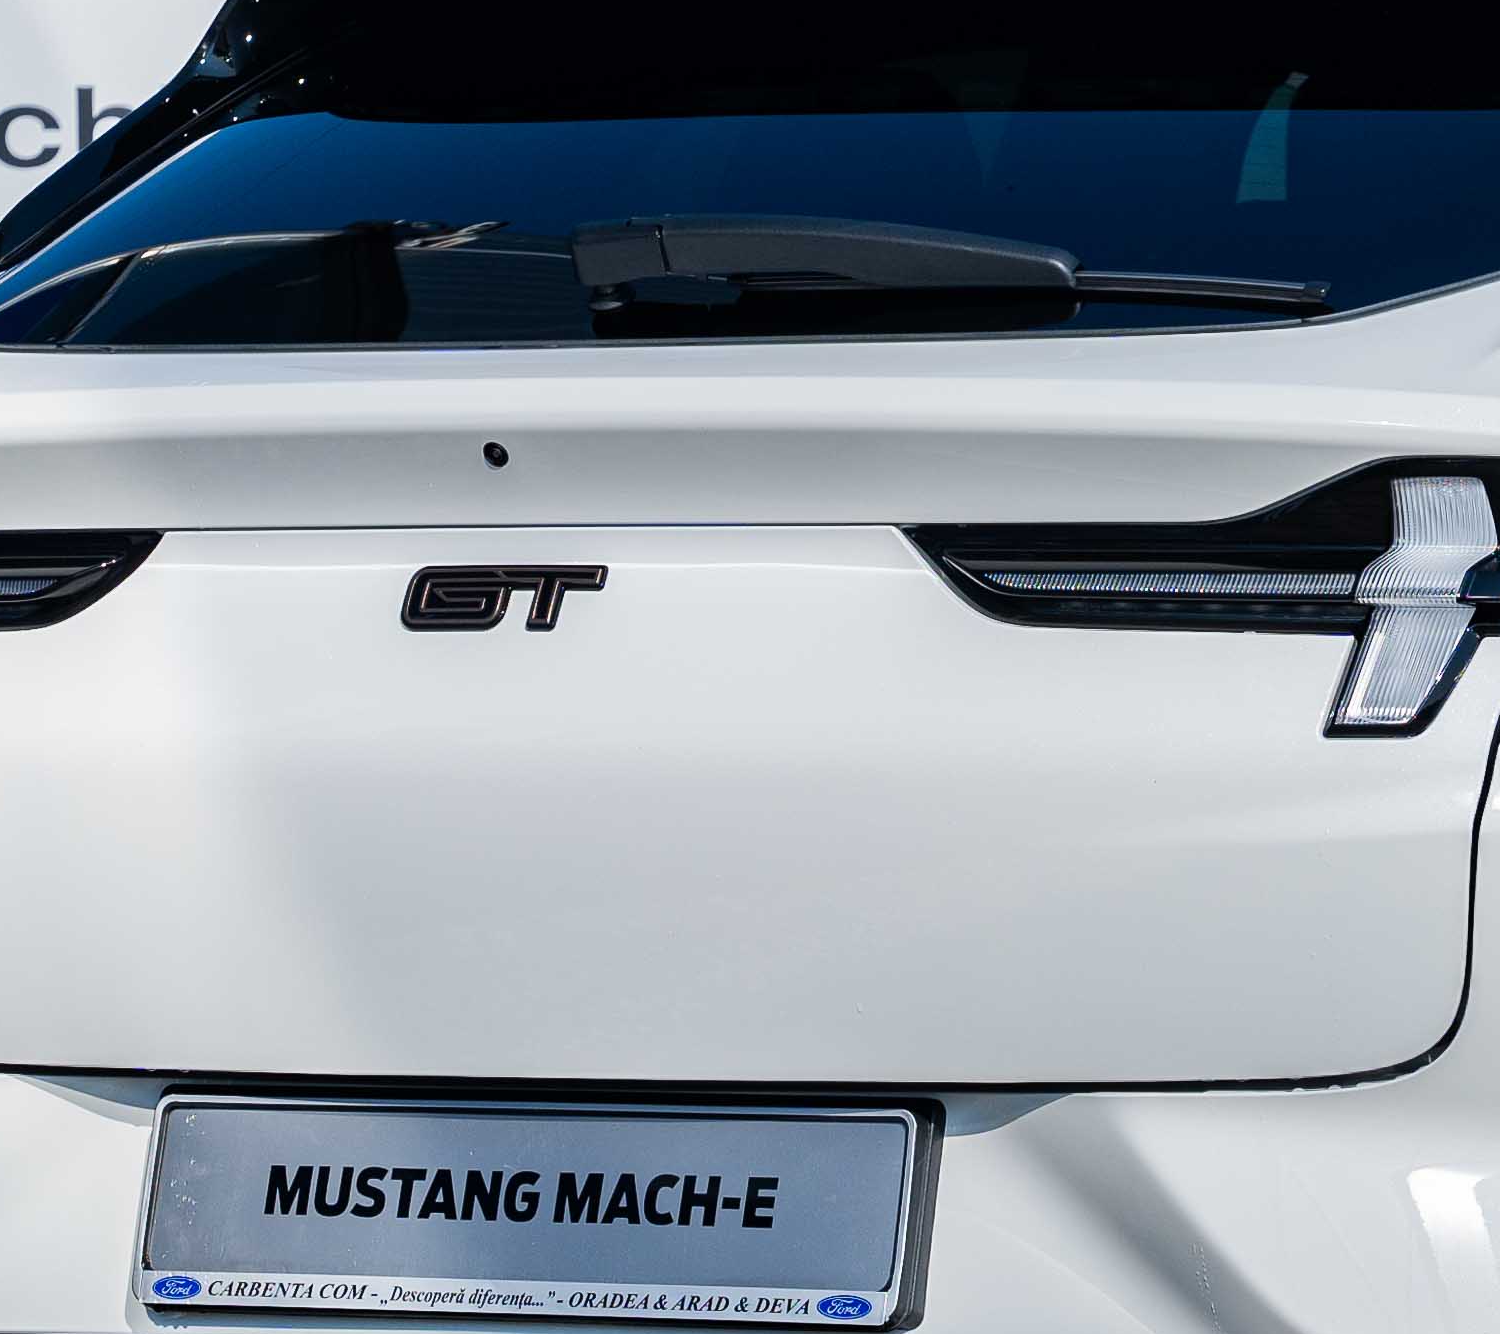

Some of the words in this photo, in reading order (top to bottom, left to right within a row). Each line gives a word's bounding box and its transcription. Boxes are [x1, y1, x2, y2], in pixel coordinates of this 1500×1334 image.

[400, 564, 609, 633] GT
[264, 1165, 541, 1223] MUSTANG
[553, 1172, 779, 1229] MACH-E
[208, 1280, 313, 1299] CARBENTA
[319, 1283, 368, 1300] COM
[569, 1291, 650, 1309] ORADEA
[653, 1294, 669, 1311] &
[671, 1295, 731, 1312] ARAD
[734, 1296, 749, 1313] &
[754, 1297, 811, 1315] DEVA
